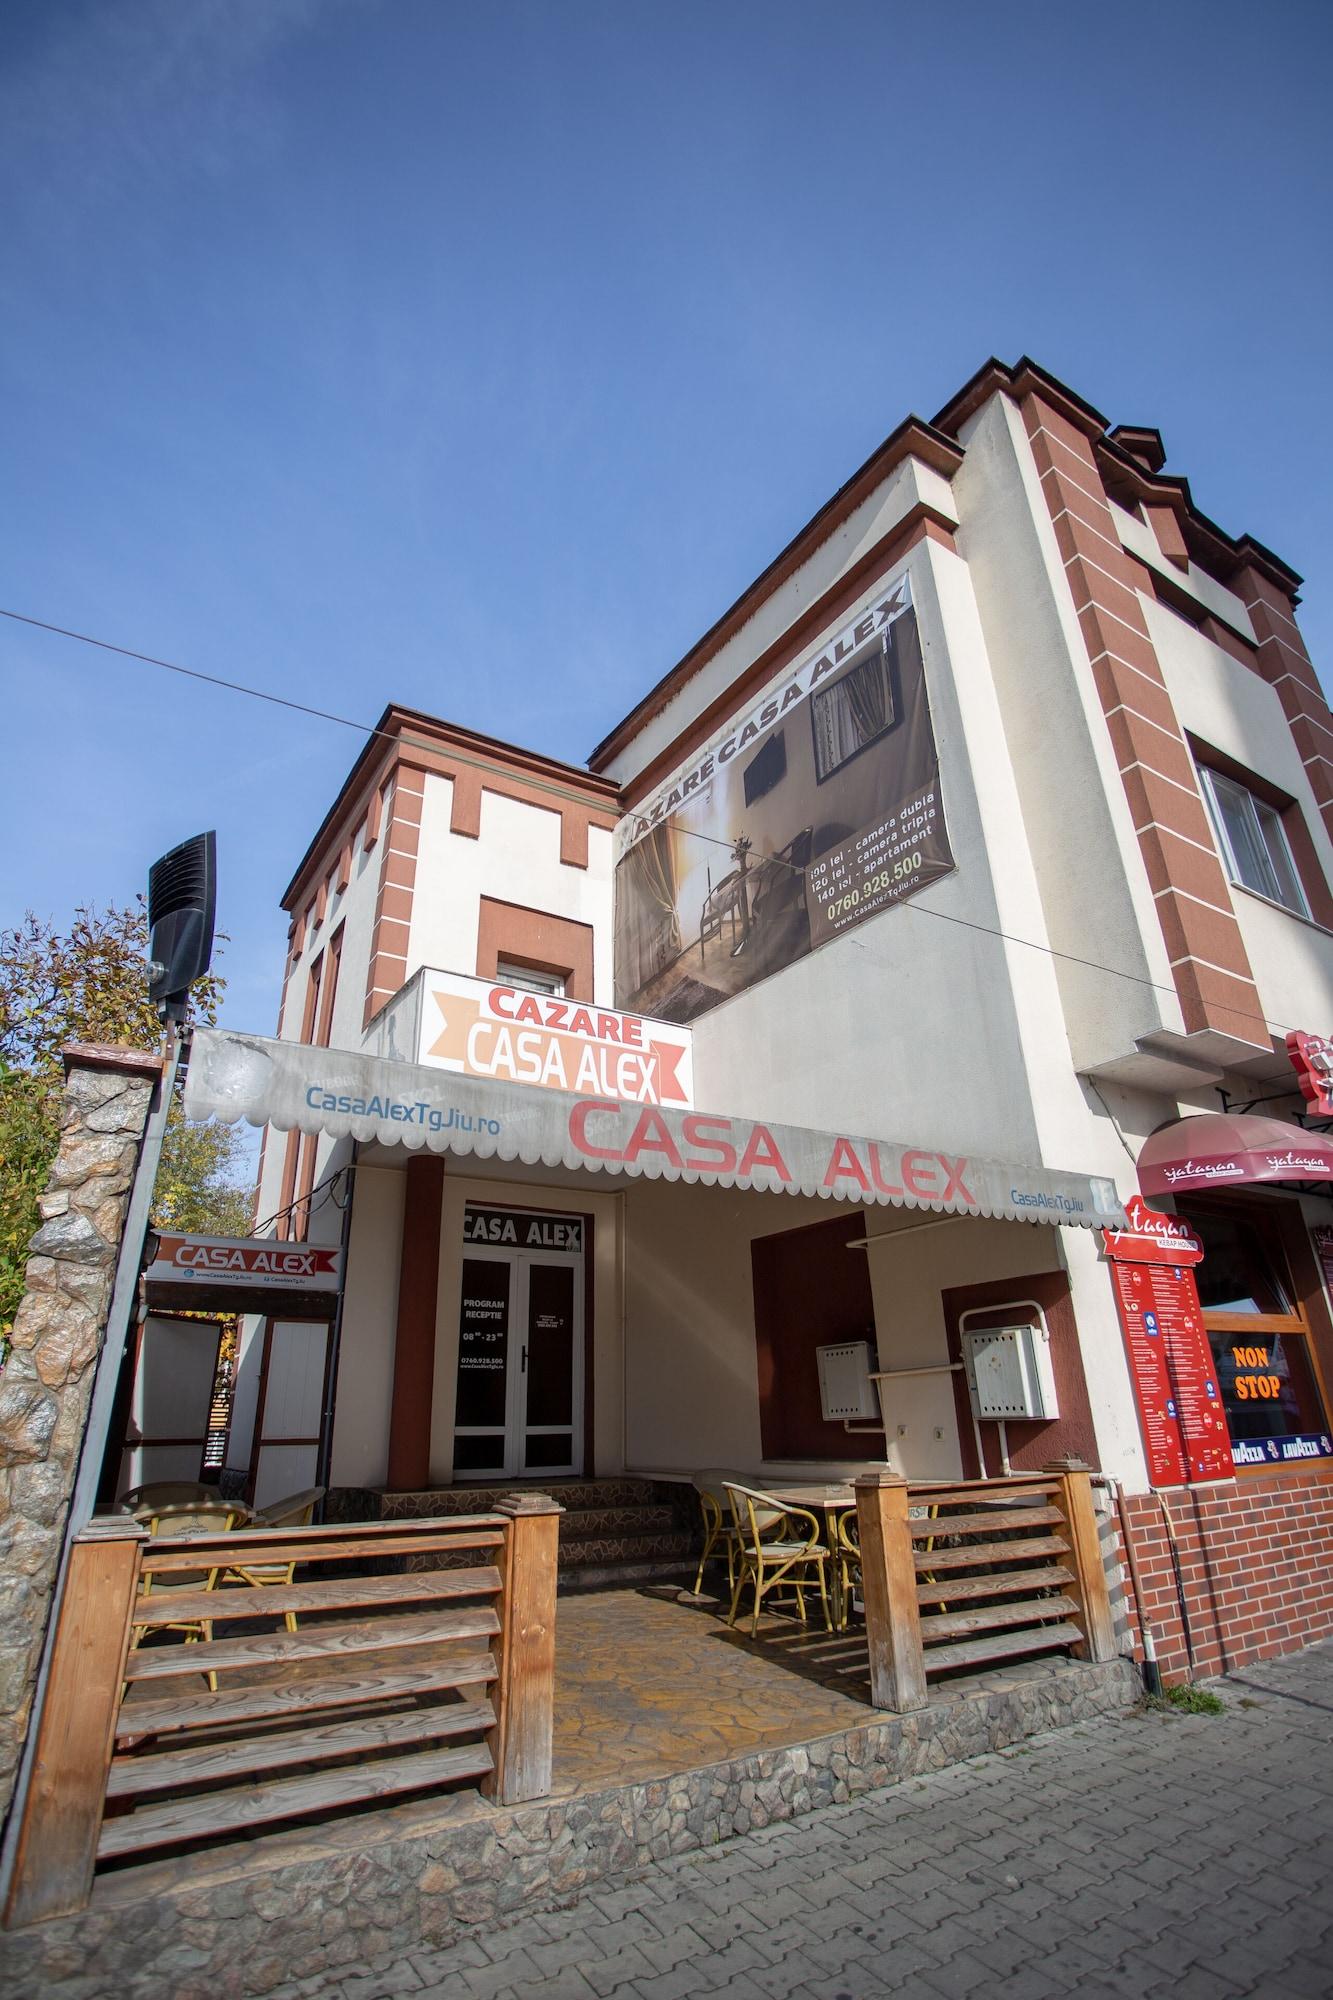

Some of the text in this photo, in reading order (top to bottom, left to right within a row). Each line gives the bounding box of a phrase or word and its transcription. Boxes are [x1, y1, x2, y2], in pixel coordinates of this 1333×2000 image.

[716, 682, 804, 765] CASA
[809, 585, 907, 688] ALEX
[855, 818, 896, 851] camera
[900, 793, 935, 820] dubla
[811, 877, 828, 893] 120
[857, 831, 898, 864] camera
[901, 808, 936, 834] tripla
[818, 888, 835, 904] 140
[864, 824, 933, 874] apartament
[827, 851, 922, 920] 0760.928.500
[488, 987, 643, 1047] CAZARE
[467, 1022, 660, 1104] CASA ALEX
[306, 1086, 500, 1136] CasaAlexTgJiu.ro
[568, 1100, 976, 1205] CASA ALEX
[464, 1215, 580, 1249] CASA ALEX
[1159, 1238, 1177, 1248] KEBAP
[175, 1246, 315, 1275] CASA ALEX
[464, 1299, 504, 1309] PROGRAM
[465, 1310, 502, 1320] RECEPTIE
[1232, 1347, 1269, 1368] NON
[1235, 1375, 1280, 1400] STOP
[1282, 1437, 1320, 1458] LAVAZZA
